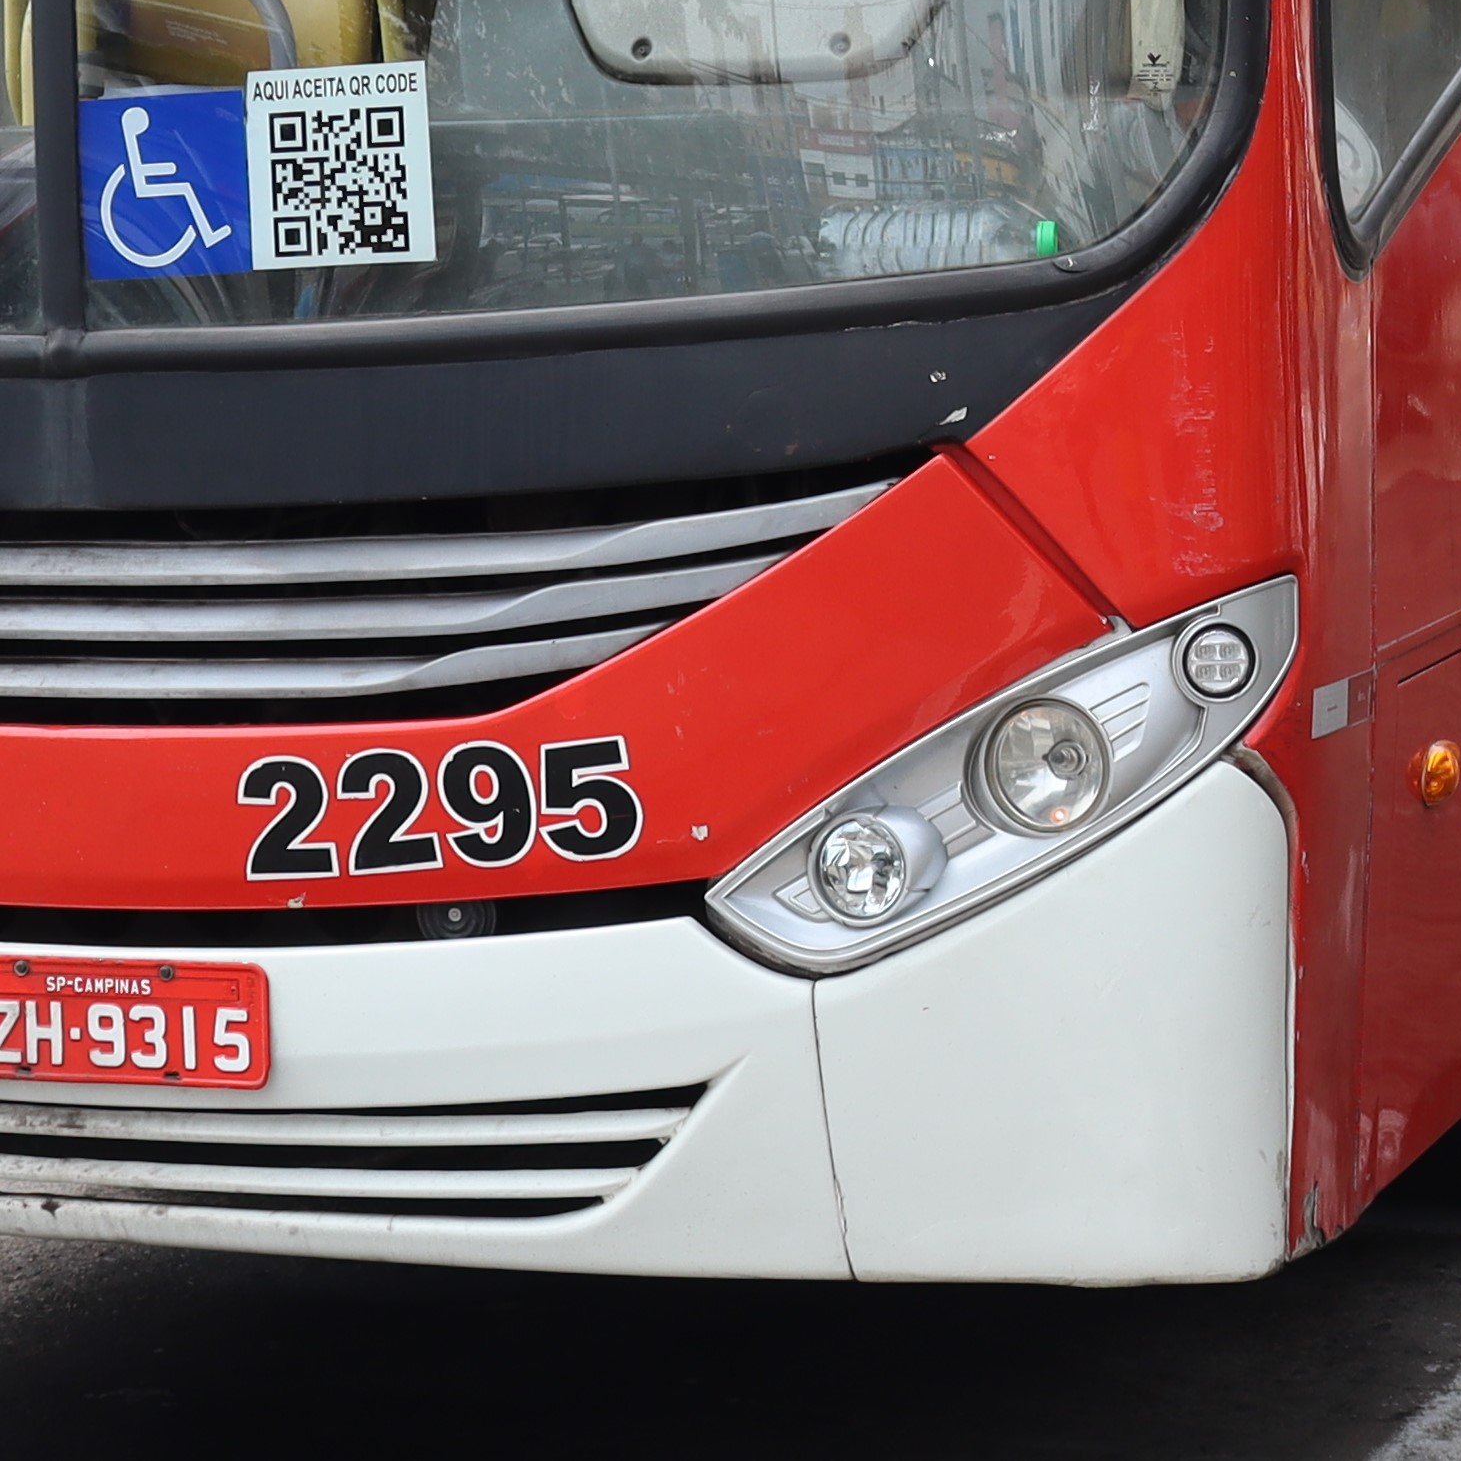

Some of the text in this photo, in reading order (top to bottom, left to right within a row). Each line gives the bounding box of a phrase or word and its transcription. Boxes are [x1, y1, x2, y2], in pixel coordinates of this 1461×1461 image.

[253, 72, 418, 101] AQUI ACEITA QR CODE
[236, 735, 644, 881] 2295
[46, 976, 151, 995] SP-CAMPINAS
